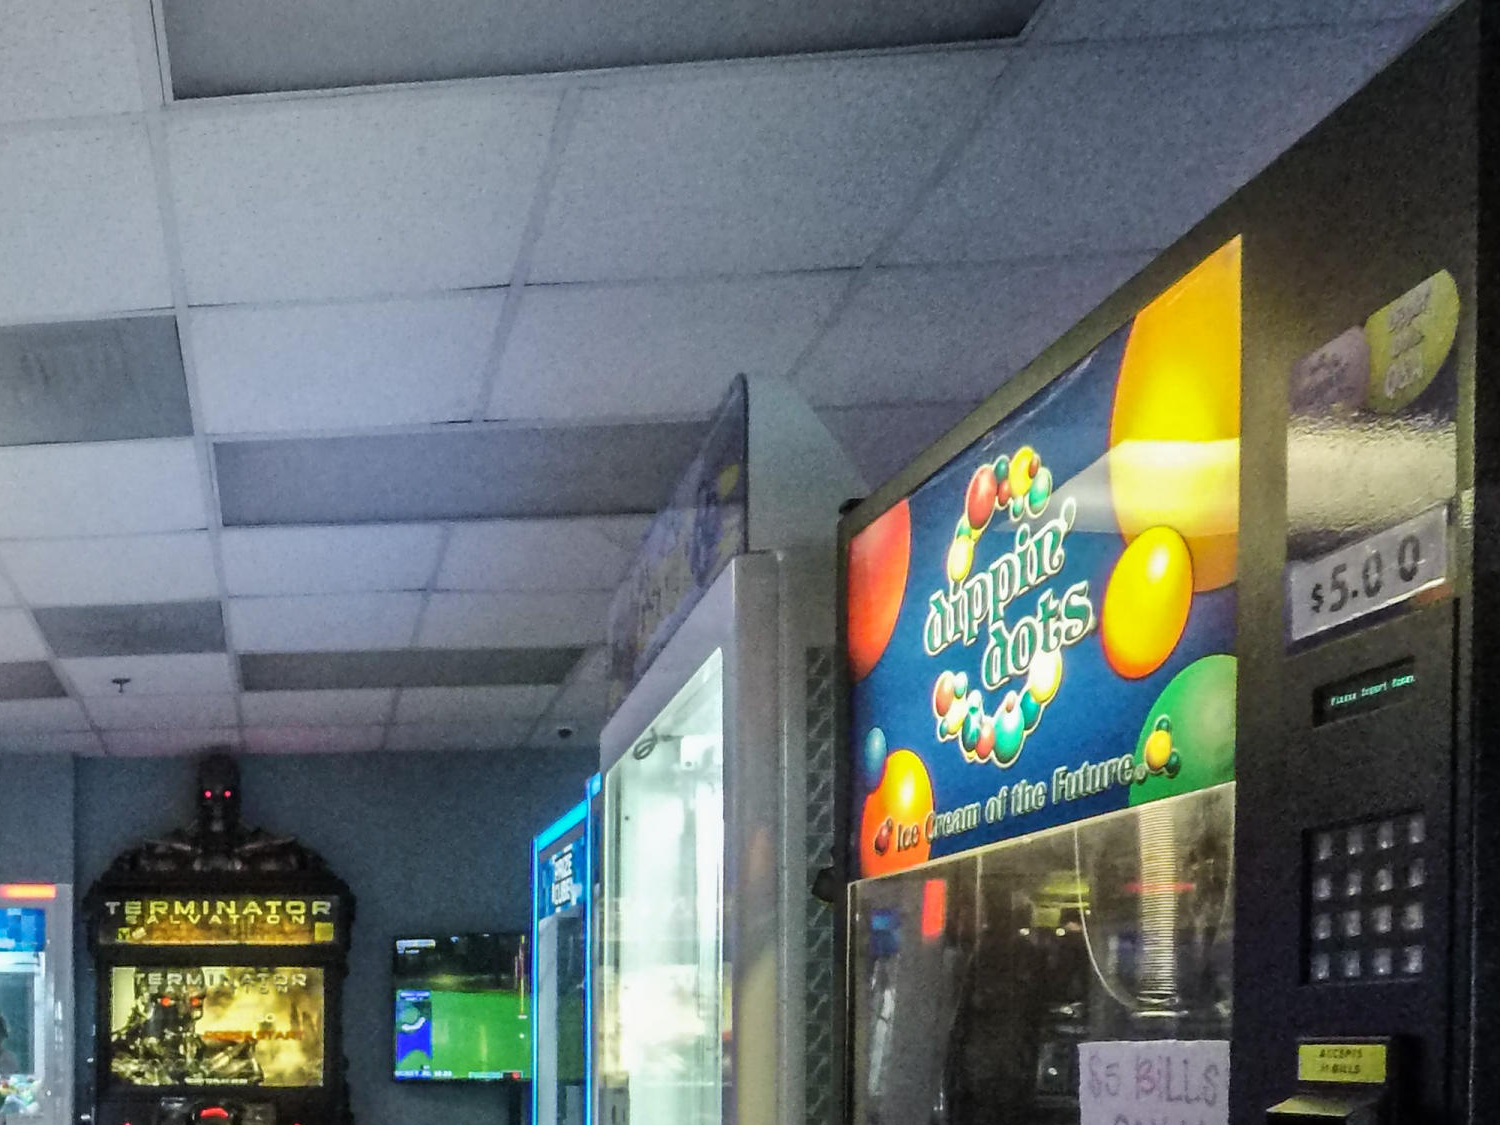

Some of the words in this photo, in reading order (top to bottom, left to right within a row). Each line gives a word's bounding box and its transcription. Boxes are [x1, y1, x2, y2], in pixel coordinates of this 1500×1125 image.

[1311, 534, 1421, 613] $5.00
[982, 579, 1093, 690] dots
[896, 822, 919, 852] Ice
[924, 803, 982, 841] Cream
[984, 784, 1008, 824] of
[1010, 778, 1047, 816] the
[104, 900, 332, 916] TERMINATOR
[124, 914, 306, 925] SALVATION
